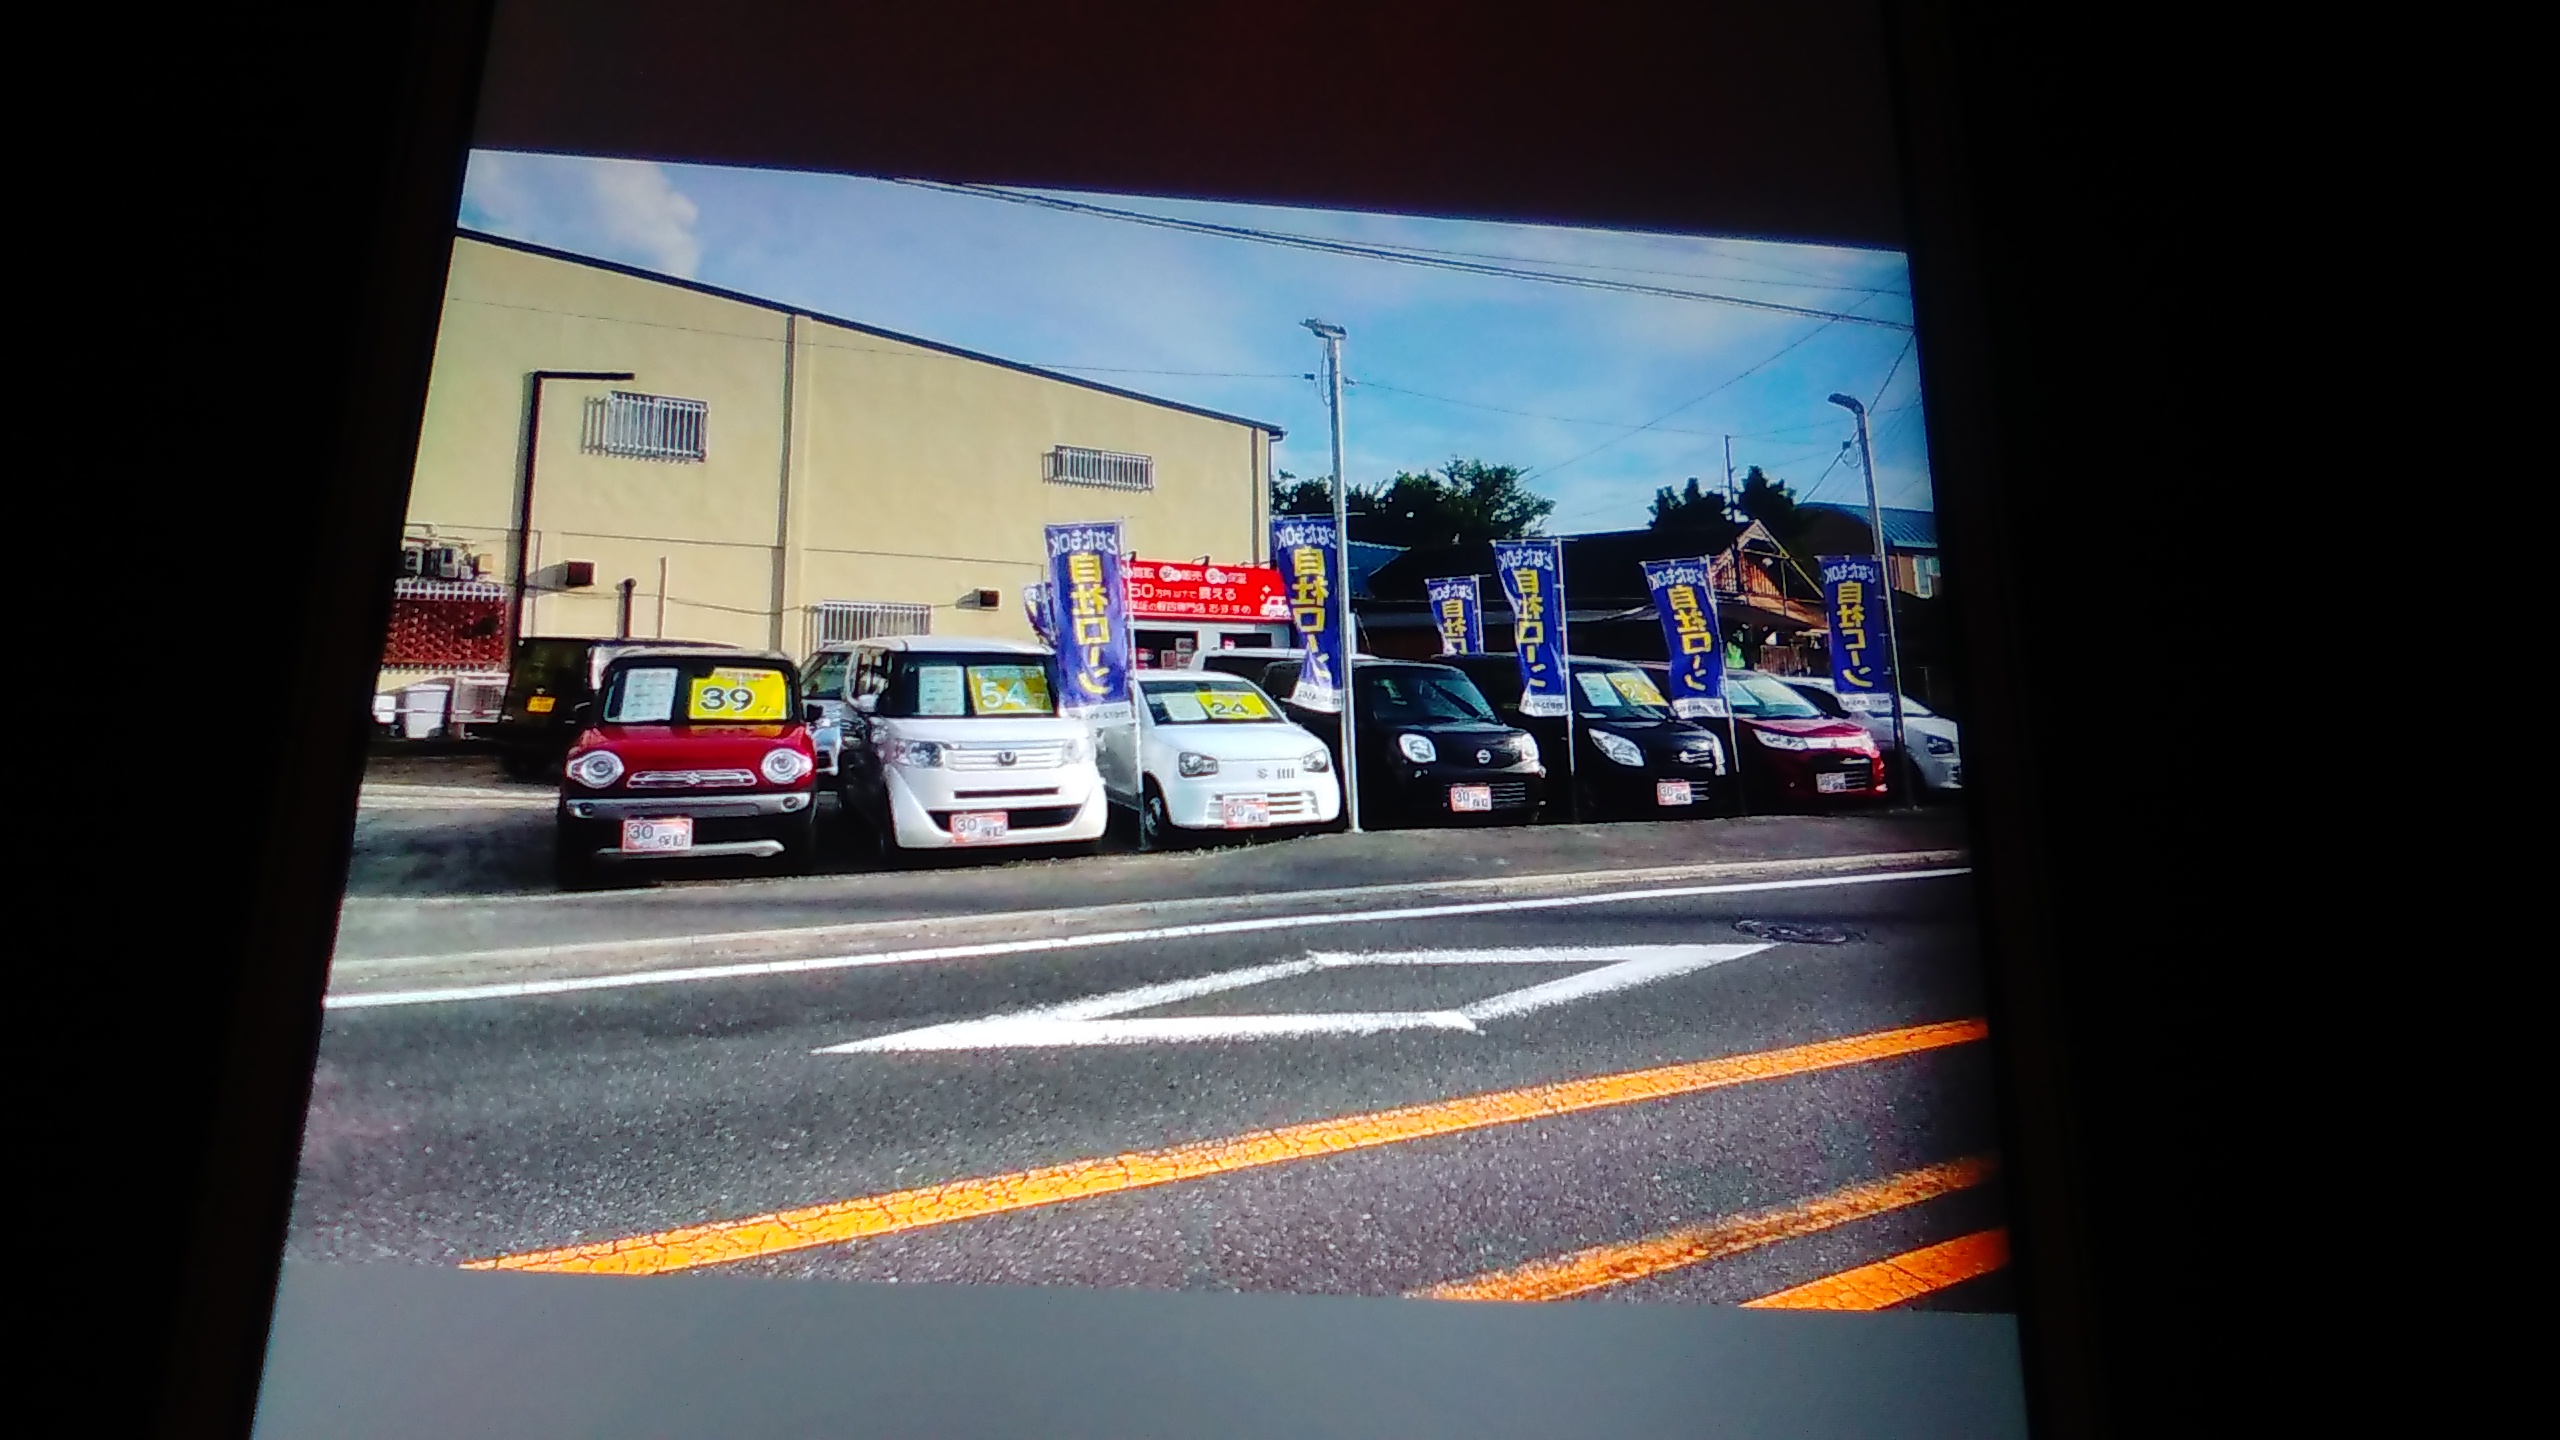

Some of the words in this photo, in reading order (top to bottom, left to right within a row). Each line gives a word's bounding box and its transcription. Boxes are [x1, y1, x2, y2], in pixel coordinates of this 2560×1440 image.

[700, 686, 755, 712] 39
[1210, 702, 1249, 715] 24
[629, 824, 654, 840] 30
[957, 818, 977, 833] 30
